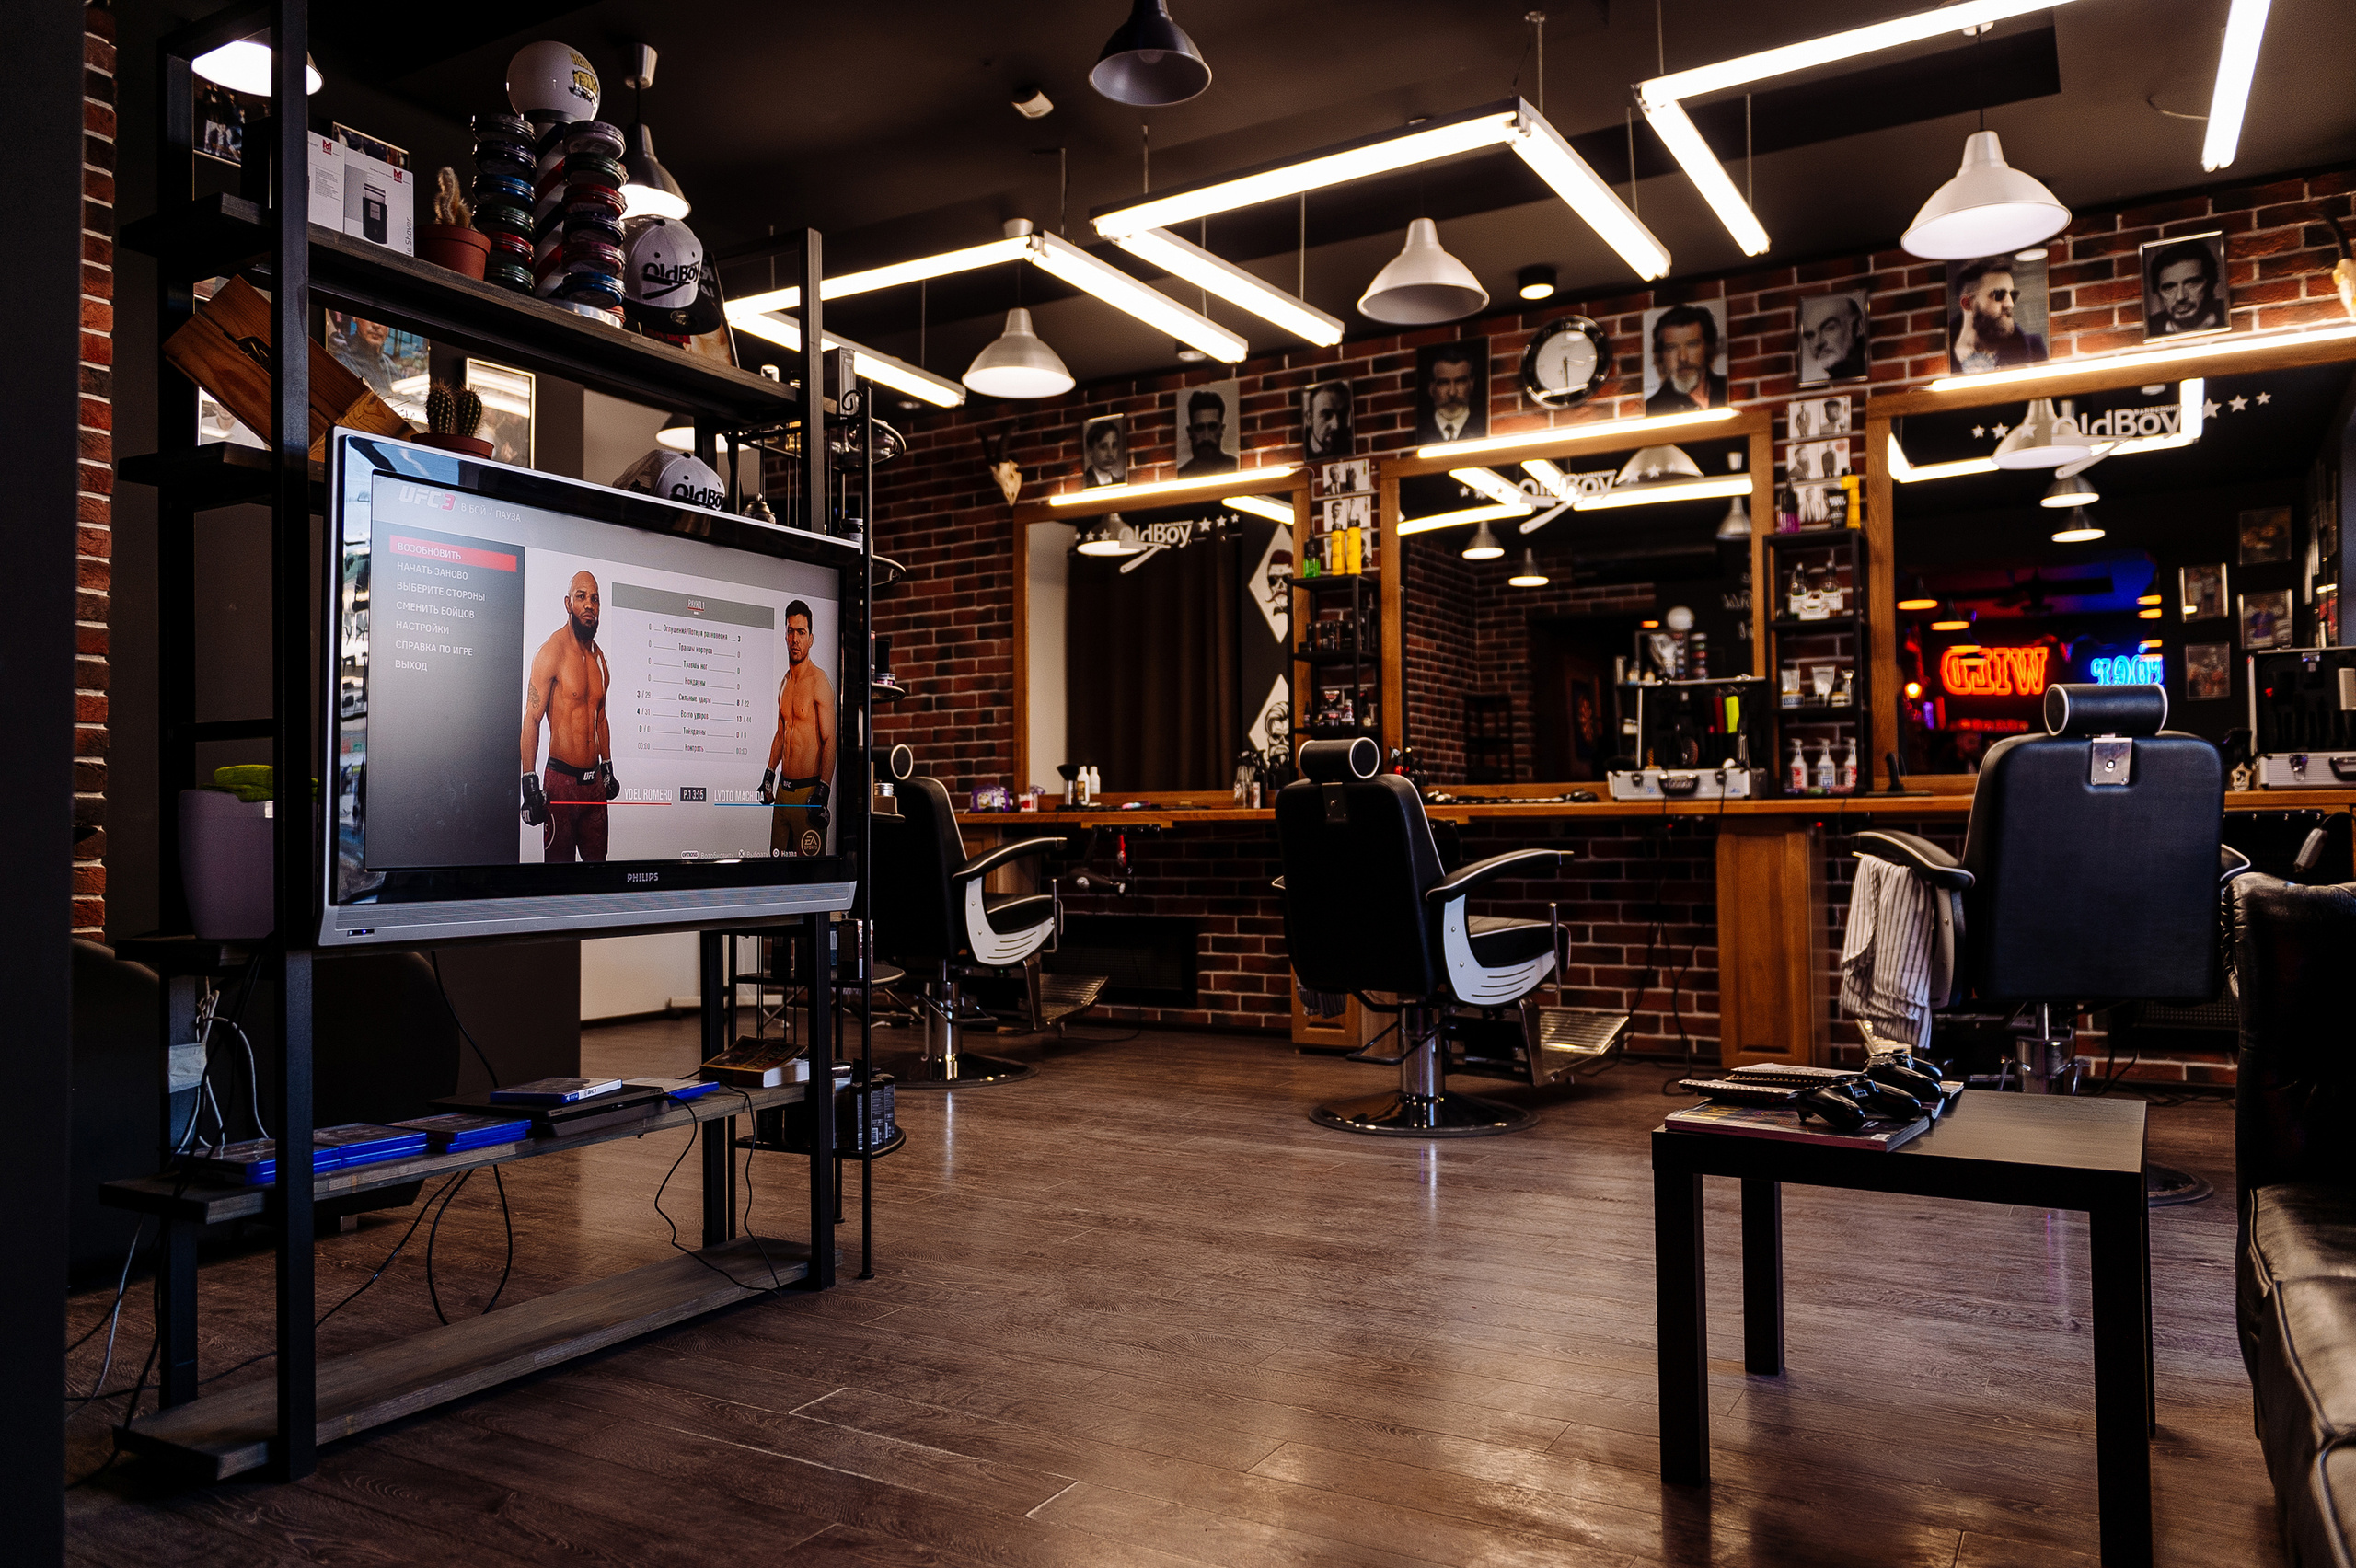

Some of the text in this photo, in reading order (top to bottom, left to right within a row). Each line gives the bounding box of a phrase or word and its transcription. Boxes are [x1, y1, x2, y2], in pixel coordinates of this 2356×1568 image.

[2133, 404, 2182, 415] BARBERSHO
[2051, 408, 2181, 439] OldBoy
[461, 502, 467, 512] В
[469, 504, 486, 516] БОЙ
[495, 509, 521, 523] ПАУЗА
[1118, 523, 1193, 548] OldBoy
[397, 542, 462, 560] ВОЗОБНОВИТЬ
[397, 562, 468, 581] НАЧАТЬ ЗАНОВО
[396, 581, 486, 602] ВЫБЕРИТЕ СТОРОНЫ
[396, 601, 475, 619] СМЕНИТЬ БОЙЦОВ
[395, 620, 450, 635] НАСТРОЙКИ
[395, 640, 474, 657] СПРАВКА ПО ИГРЕ
[678, 642, 695, 652] Травмы
[696, 646, 713, 655] корпуса
[395, 659, 428, 672] ВЫХОД
[683, 660, 699, 669] Травмы
[684, 677, 706, 687] Нокдауны
[678, 692, 697, 703] Сильные
[698, 696, 712, 704] удары
[694, 712, 709, 720] ударов
[684, 744, 704, 753] Контроль
[583, 771, 595, 781] UFC
[624, 787, 673, 801] YOEL ROMERO
[714, 789, 765, 802] LYOTO MACHIDA
[804, 836, 818, 845] EA
[627, 872, 659, 882] PHILIPS
